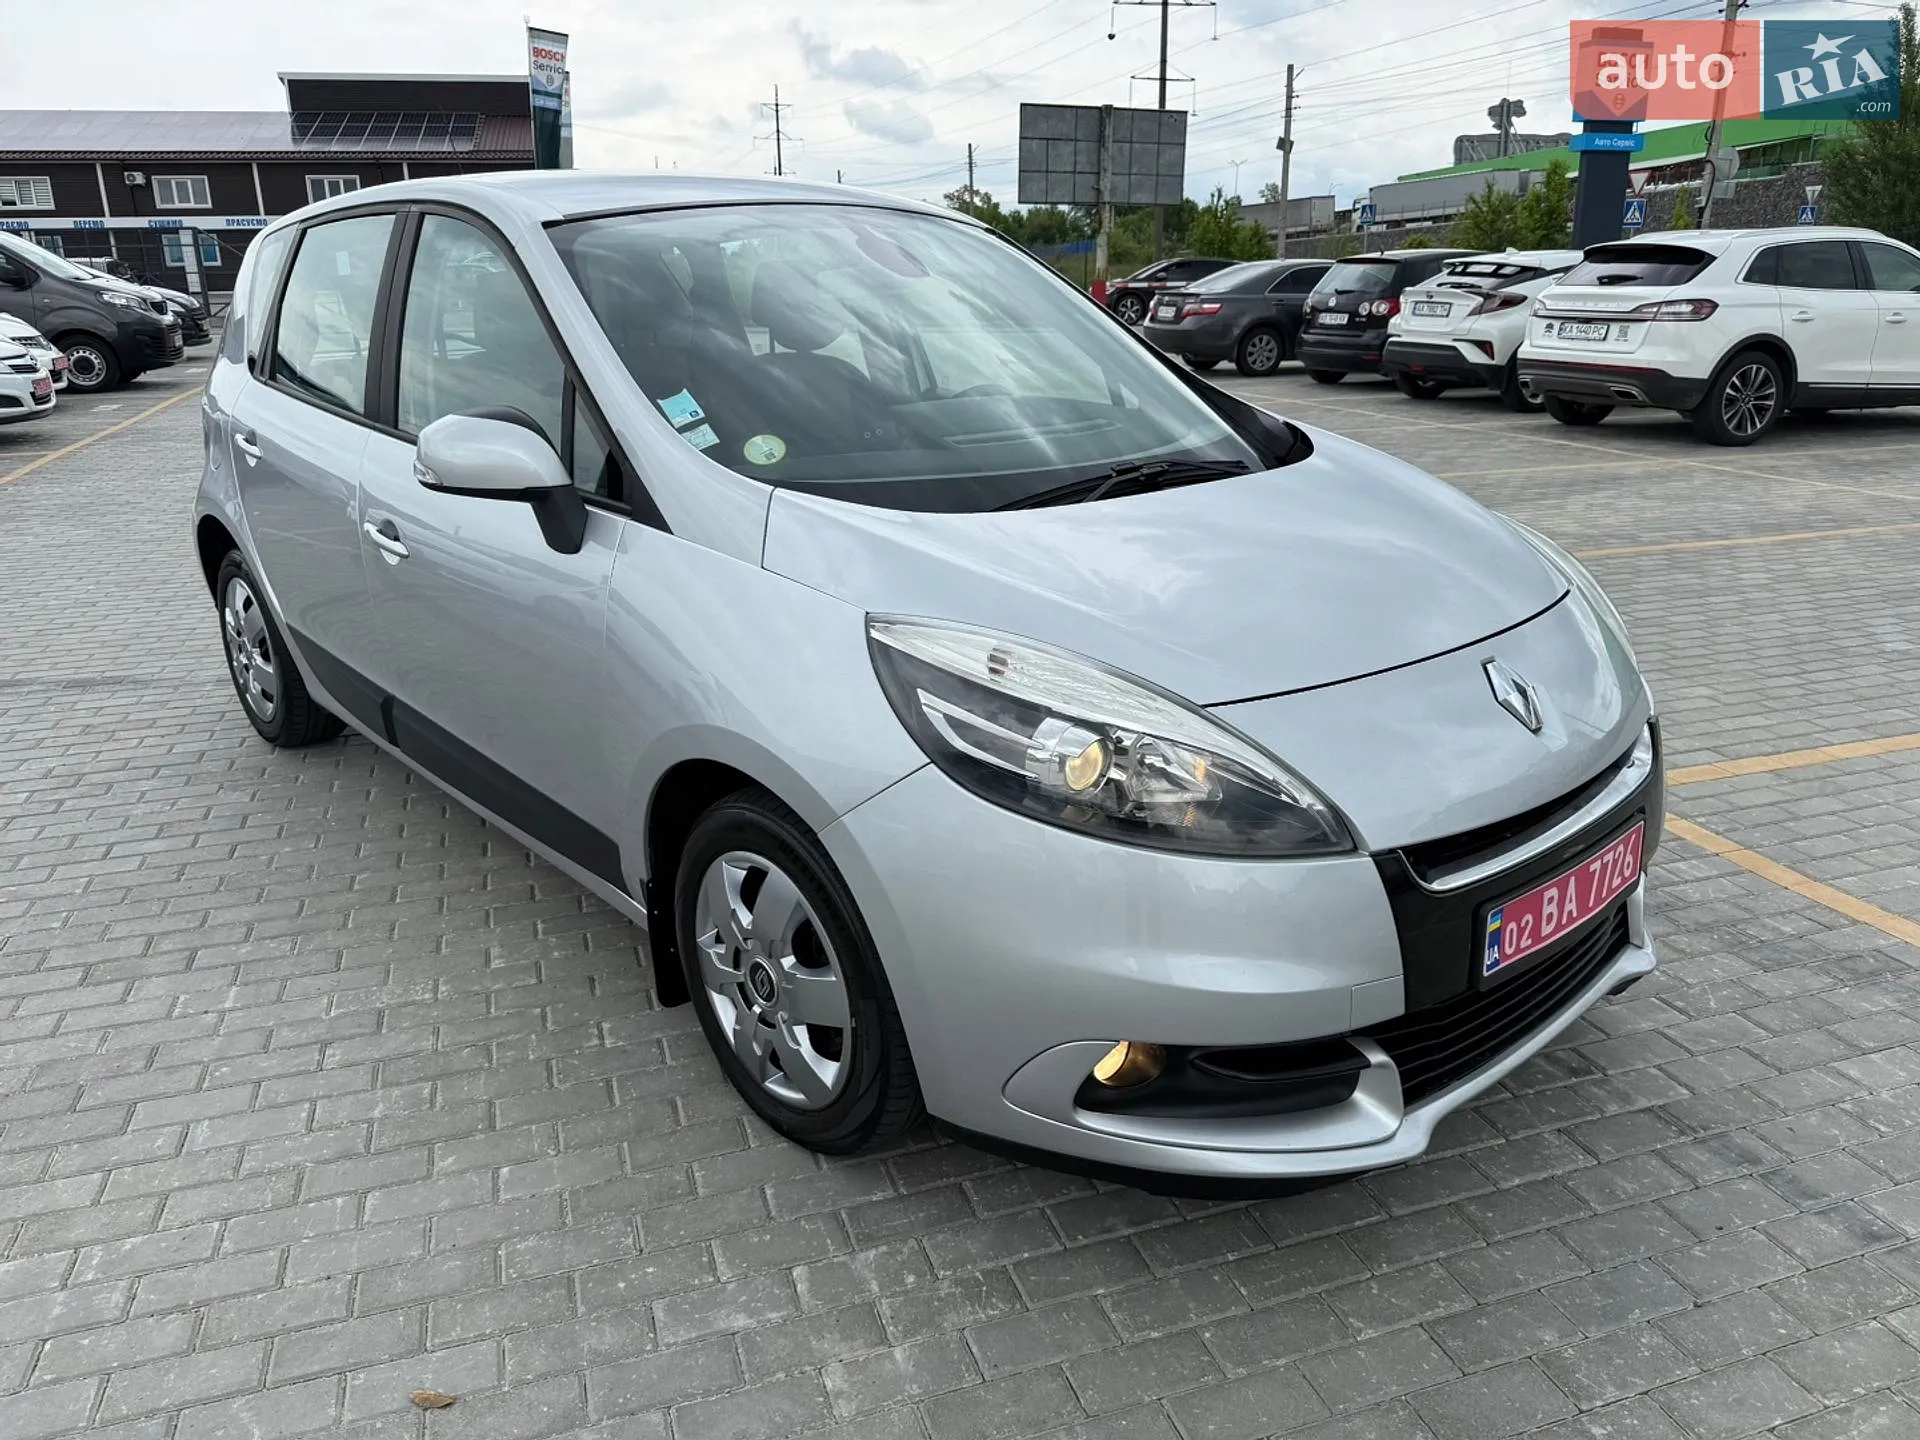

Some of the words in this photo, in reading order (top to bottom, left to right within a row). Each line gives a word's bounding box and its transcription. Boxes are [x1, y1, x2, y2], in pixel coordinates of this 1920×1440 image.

[1594, 138, 1611, 147] Авто
[1592, 326, 1605, 336] PC
[1504, 913, 1533, 956] 02
[1541, 876, 1578, 937] BA
[1588, 833, 1637, 908] 7726
[1486, 945, 1499, 965] UA
